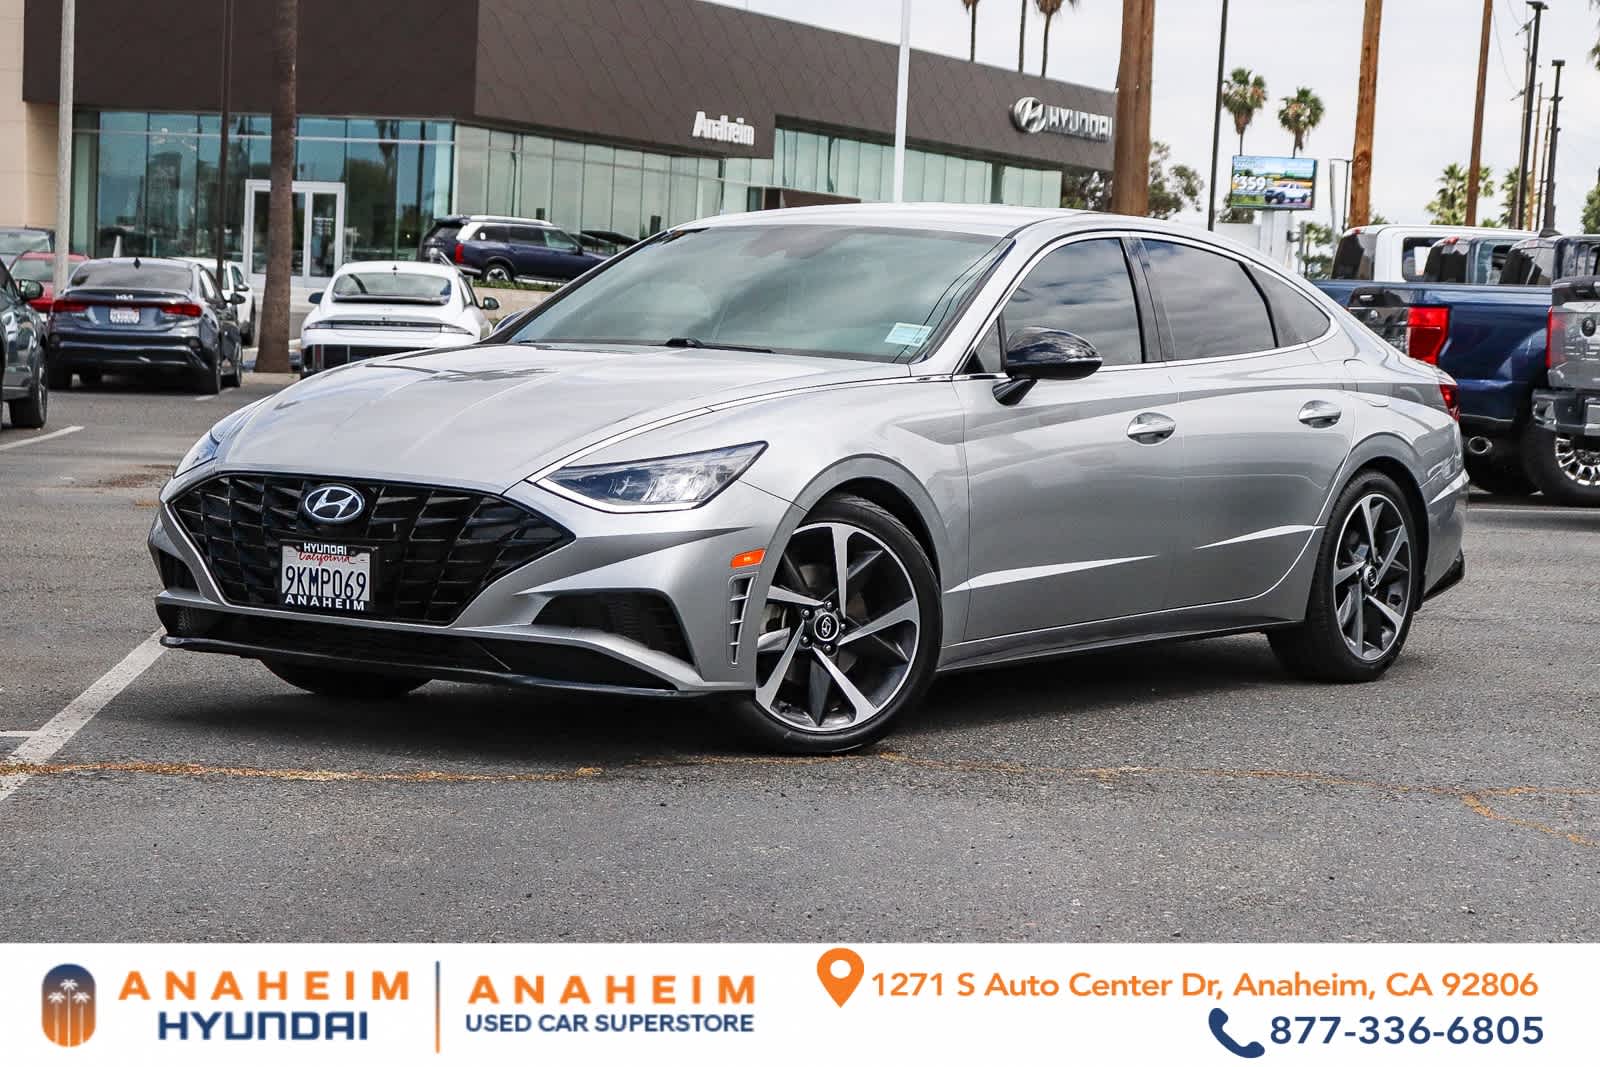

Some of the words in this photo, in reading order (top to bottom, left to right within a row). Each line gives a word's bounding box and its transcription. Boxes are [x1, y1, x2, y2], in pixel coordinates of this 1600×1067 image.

[692, 110, 755, 146] Anaheim
[1048, 105, 1112, 138] HYUNDAI
[303, 543, 347, 555] HYUNDAI
[285, 565, 367, 601] 9KMP069
[284, 594, 365, 611] ANAHEIM
